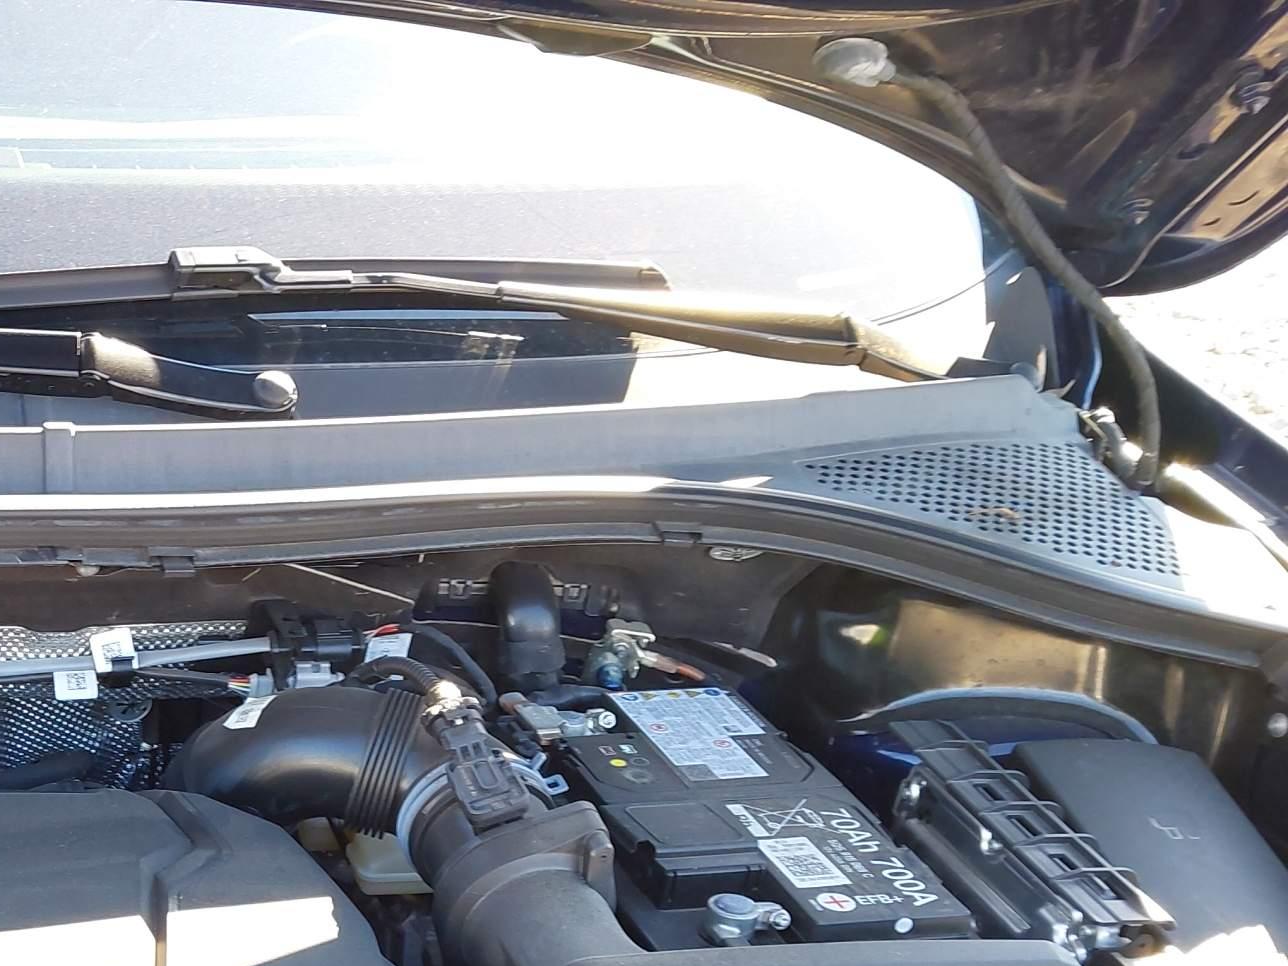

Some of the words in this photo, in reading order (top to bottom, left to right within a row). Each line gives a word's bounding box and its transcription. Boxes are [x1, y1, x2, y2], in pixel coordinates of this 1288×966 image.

[820, 808, 881, 852] 70Ah
[870, 856, 939, 906] 700A
[855, 894, 904, 905] EFB+
